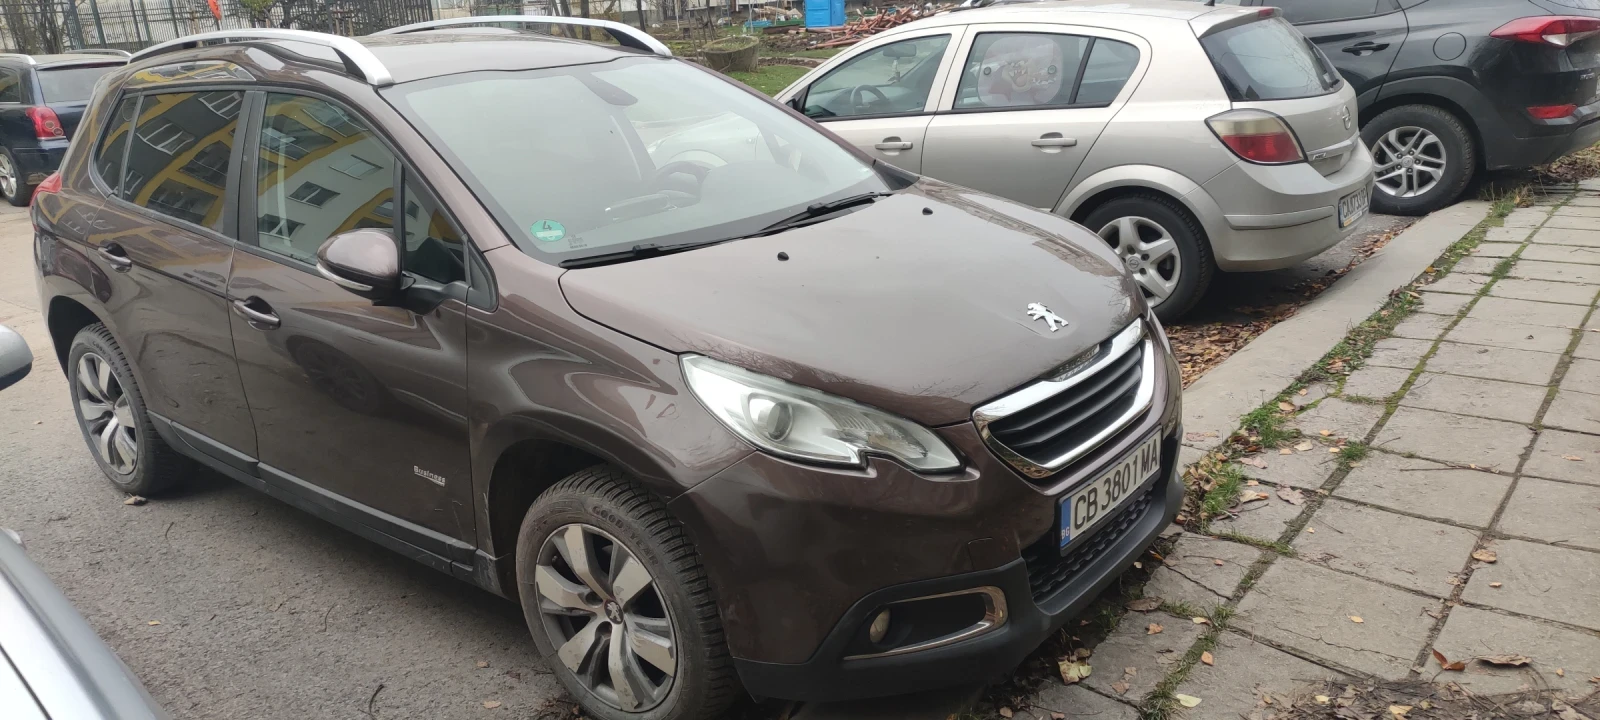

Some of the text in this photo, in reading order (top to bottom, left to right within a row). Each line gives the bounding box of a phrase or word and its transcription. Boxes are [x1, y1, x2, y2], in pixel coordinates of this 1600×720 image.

[542, 220, 553, 231] 4
[1074, 438, 1158, 530] CB 3801 MA
[1061, 526, 1070, 540] BG
